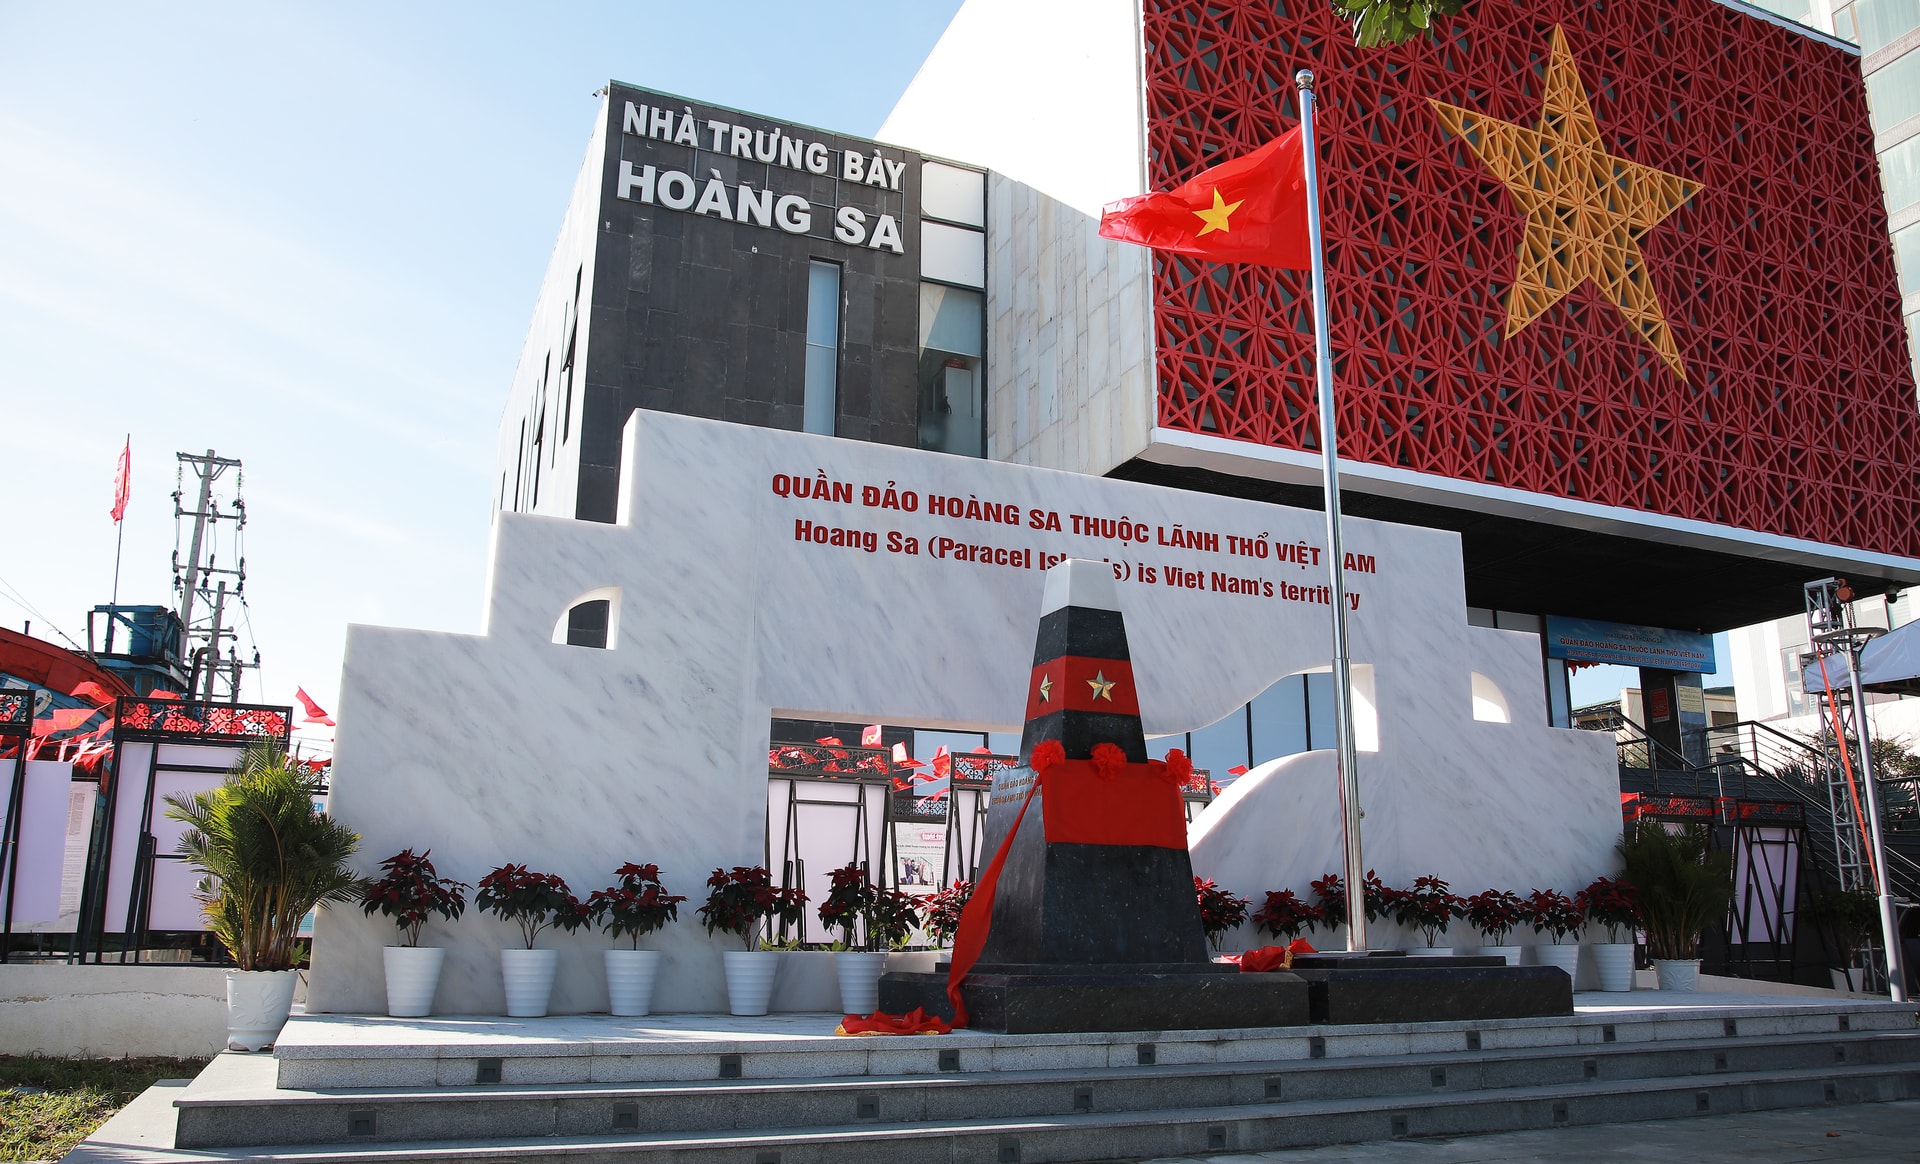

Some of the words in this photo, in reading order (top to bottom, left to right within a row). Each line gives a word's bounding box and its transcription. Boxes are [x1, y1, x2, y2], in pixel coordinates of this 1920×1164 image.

[622, 100, 699, 147] NHÀ
[707, 119, 829, 176] TRƯNG
[843, 149, 906, 190] BÀY
[617, 160, 811, 235] HOÀNG
[834, 206, 905, 254] SA
[772, 468, 853, 504] QUẦN
[862, 480, 919, 513] ĐẢO
[928, 494, 1020, 526] HOÀNG
[1028, 509, 1062, 533] SA
[1070, 514, 1149, 547] THUỘC
[1157, 524, 1219, 553] LÃNH
[1226, 531, 1269, 559] THỔ
[1275, 540, 1321, 570] VIỆT
[1332, 551, 1376, 574] AM
[795, 519, 878, 553] Hoang
[886, 531, 919, 556] Sa
[927, 535, 1031, 570] (Paracel
[1039, 551, 1131, 582] Iss)
[1138, 562, 1157, 585] is
[1163, 565, 1205, 590] Viet
[1211, 571, 1274, 598] Nam's
[1280, 580, 1361, 611] territy
